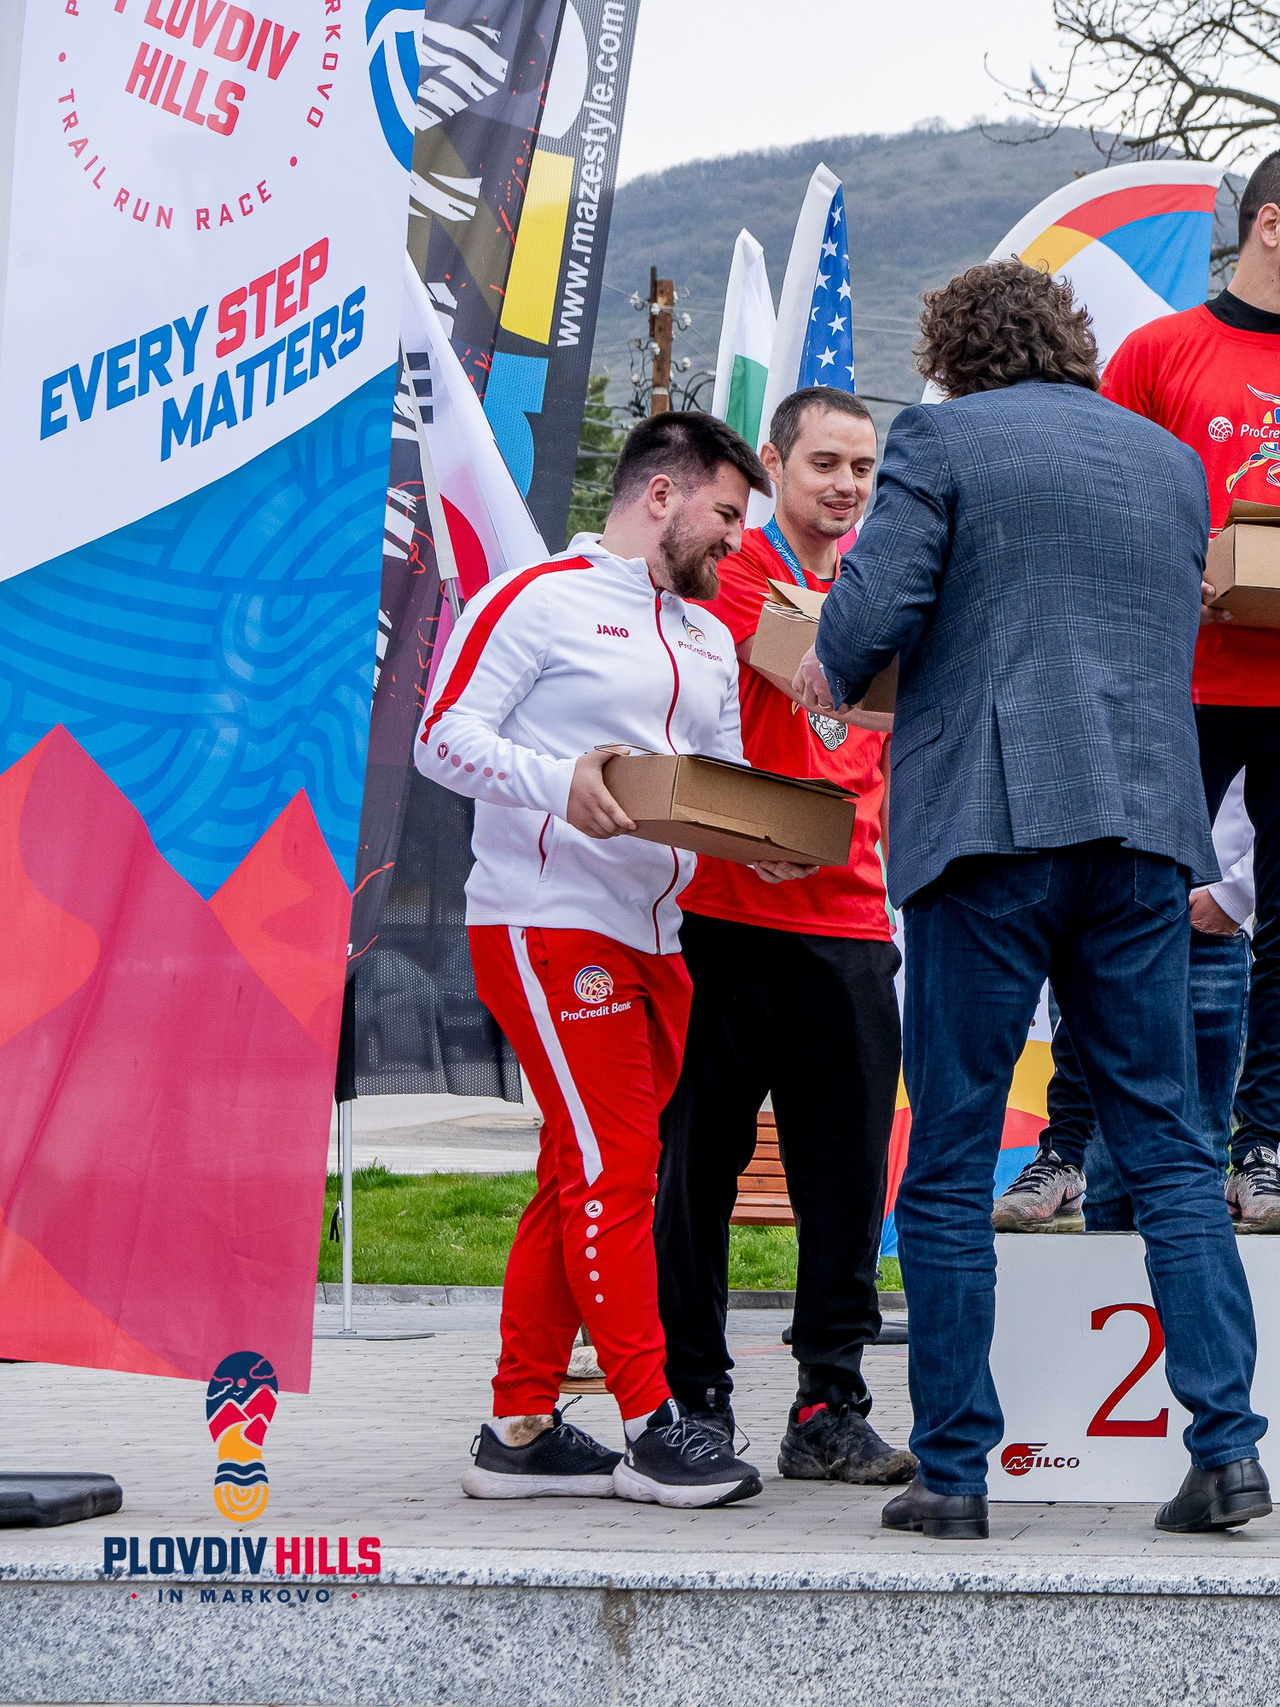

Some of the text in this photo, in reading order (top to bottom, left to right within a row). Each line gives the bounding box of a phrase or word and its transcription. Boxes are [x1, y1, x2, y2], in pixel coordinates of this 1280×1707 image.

[114, 0, 300, 81] LOVDIV
[125, 41, 246, 136] HILLS
[58, 88, 272, 230] TRAIL RUN RACE
[556, 0, 626, 348] www.mazestyle.com
[40, 237, 329, 441] EVERY STEP
[160, 285, 366, 463] MATTERS
[596, 624, 629, 639] JAKO
[677, 640, 723, 662] ProCredit Bank
[561, 1000, 632, 1022] ProCredit Bank
[1085, 1302, 1169, 1438] 2
[1004, 1455, 1080, 1469] MILCO
